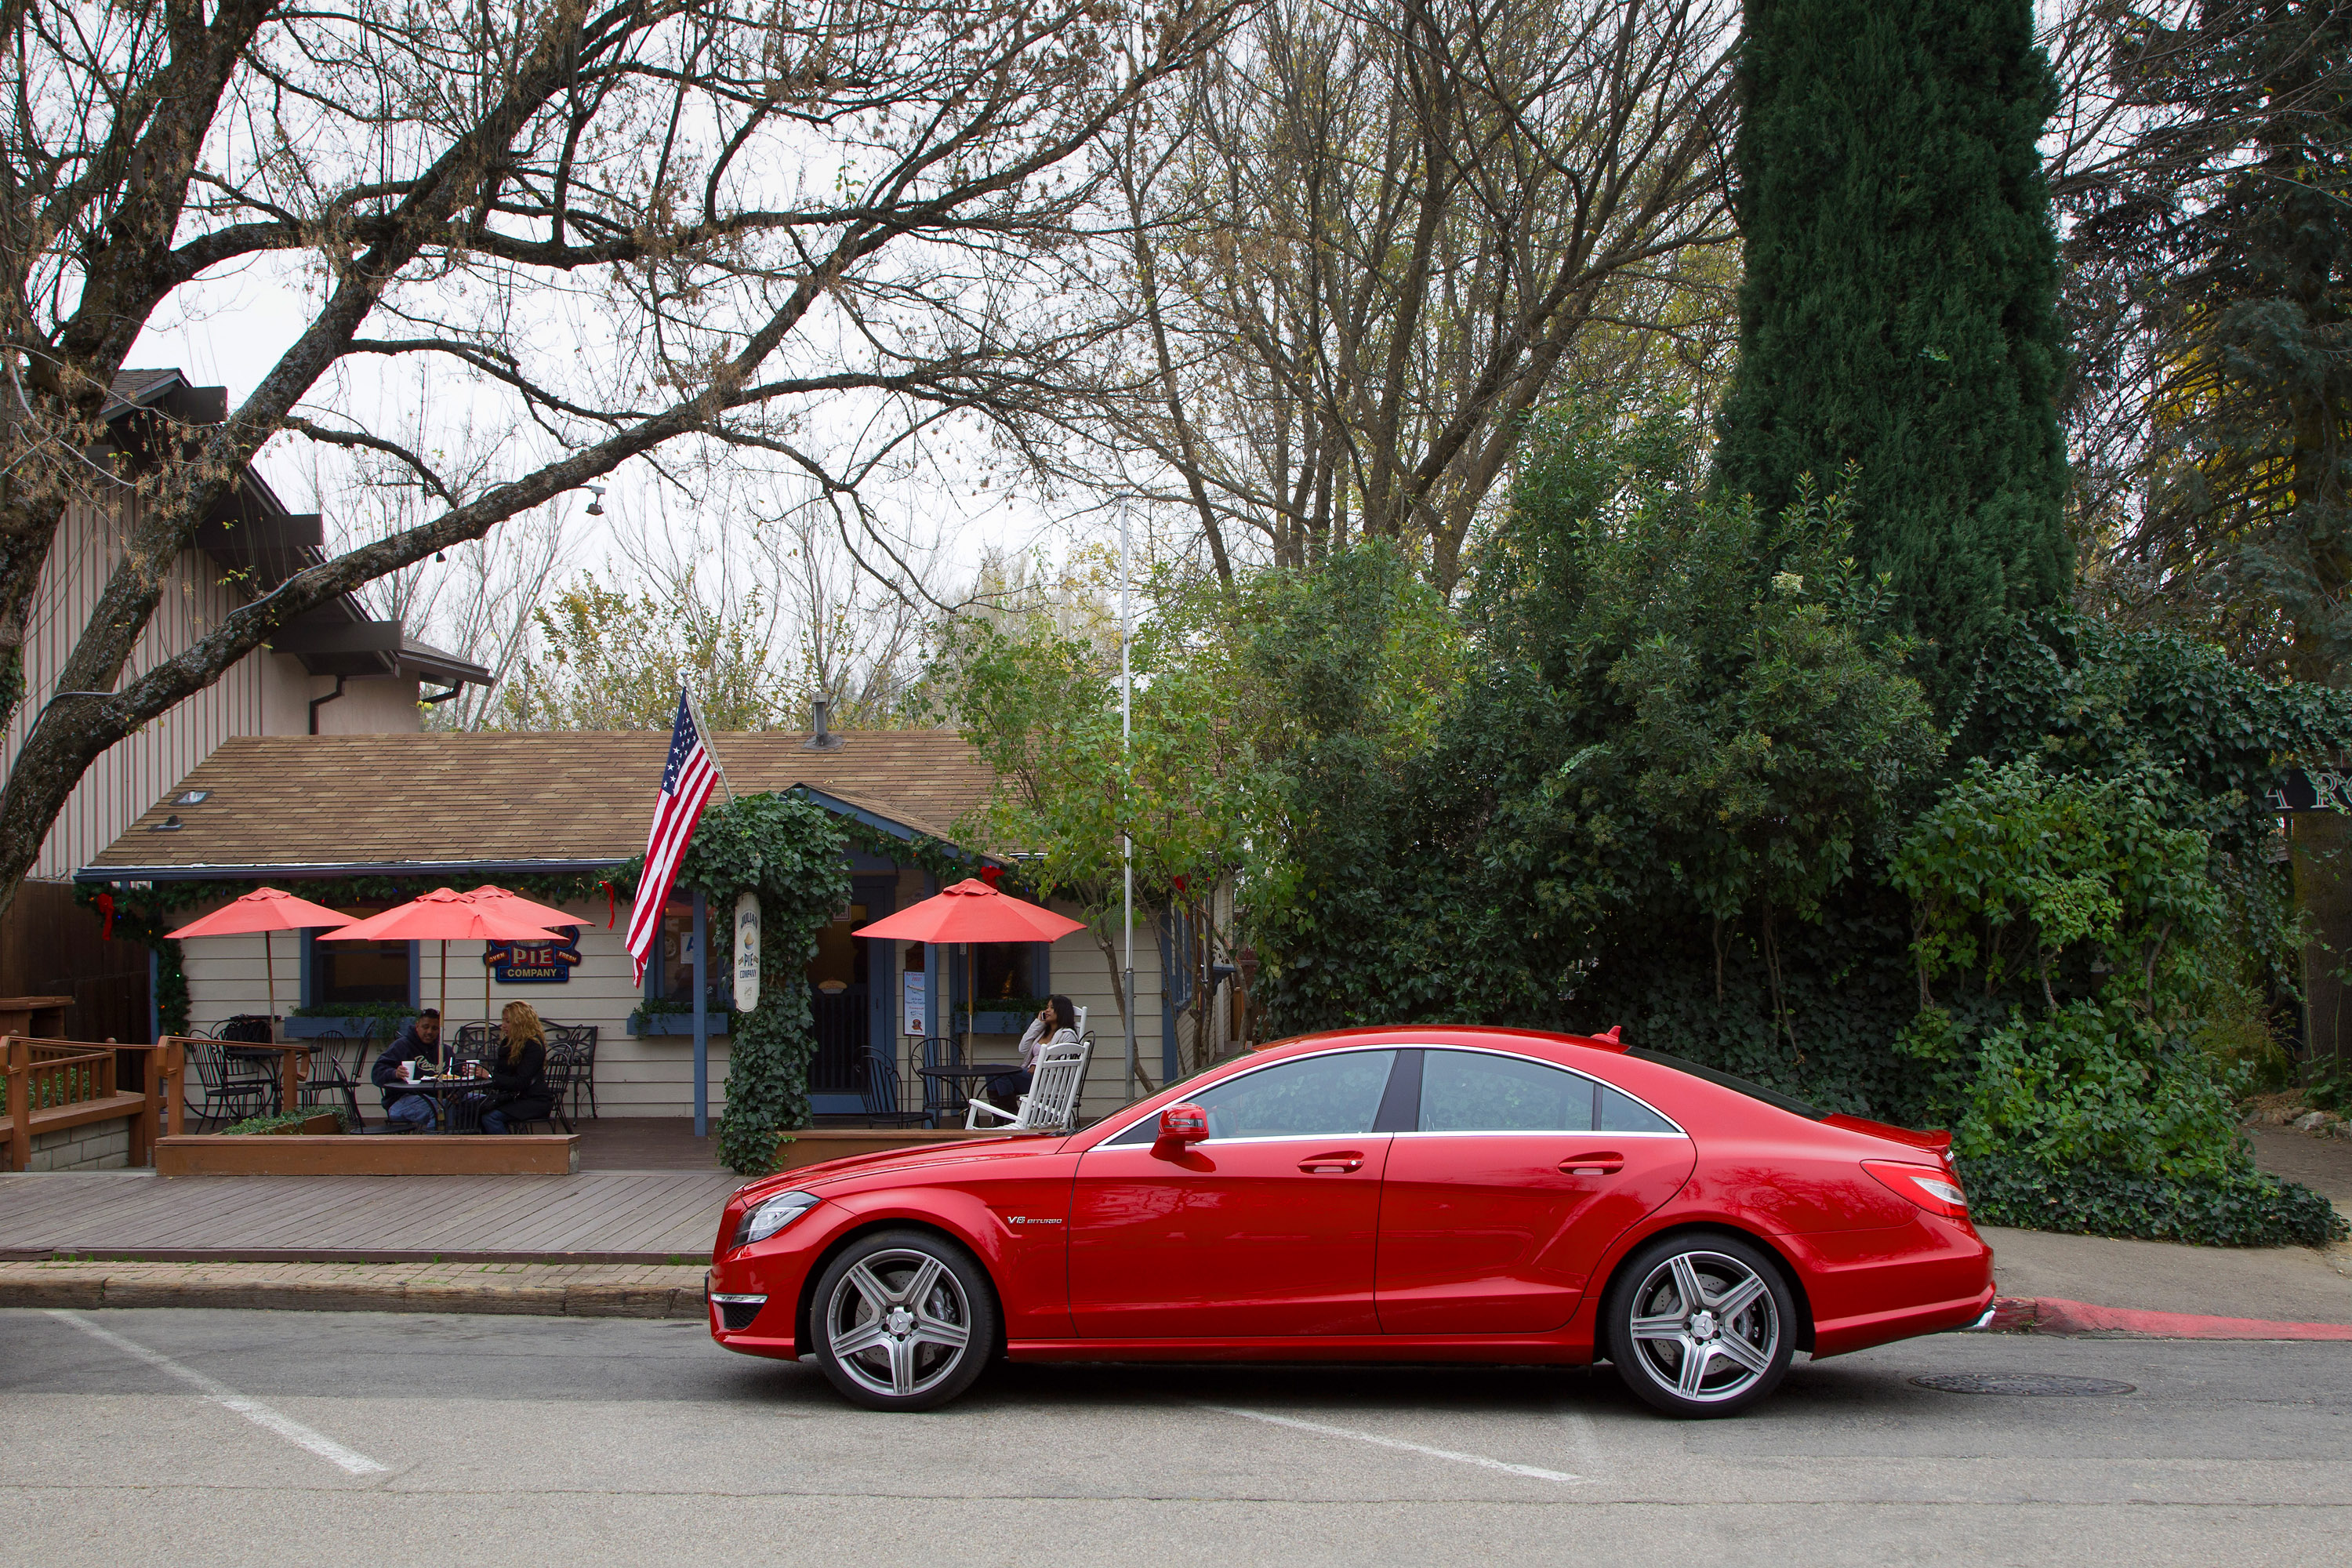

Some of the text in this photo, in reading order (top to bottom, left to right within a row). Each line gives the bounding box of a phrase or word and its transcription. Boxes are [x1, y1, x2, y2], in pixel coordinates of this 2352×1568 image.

[741, 913, 758, 929] JULIAN
[513, 947, 554, 965] PIE
[558, 951, 578, 962] FRESH
[744, 953, 753, 967] PIE
[507, 968, 557, 978] COMPANY
[739, 969, 757, 978] COMPANY
